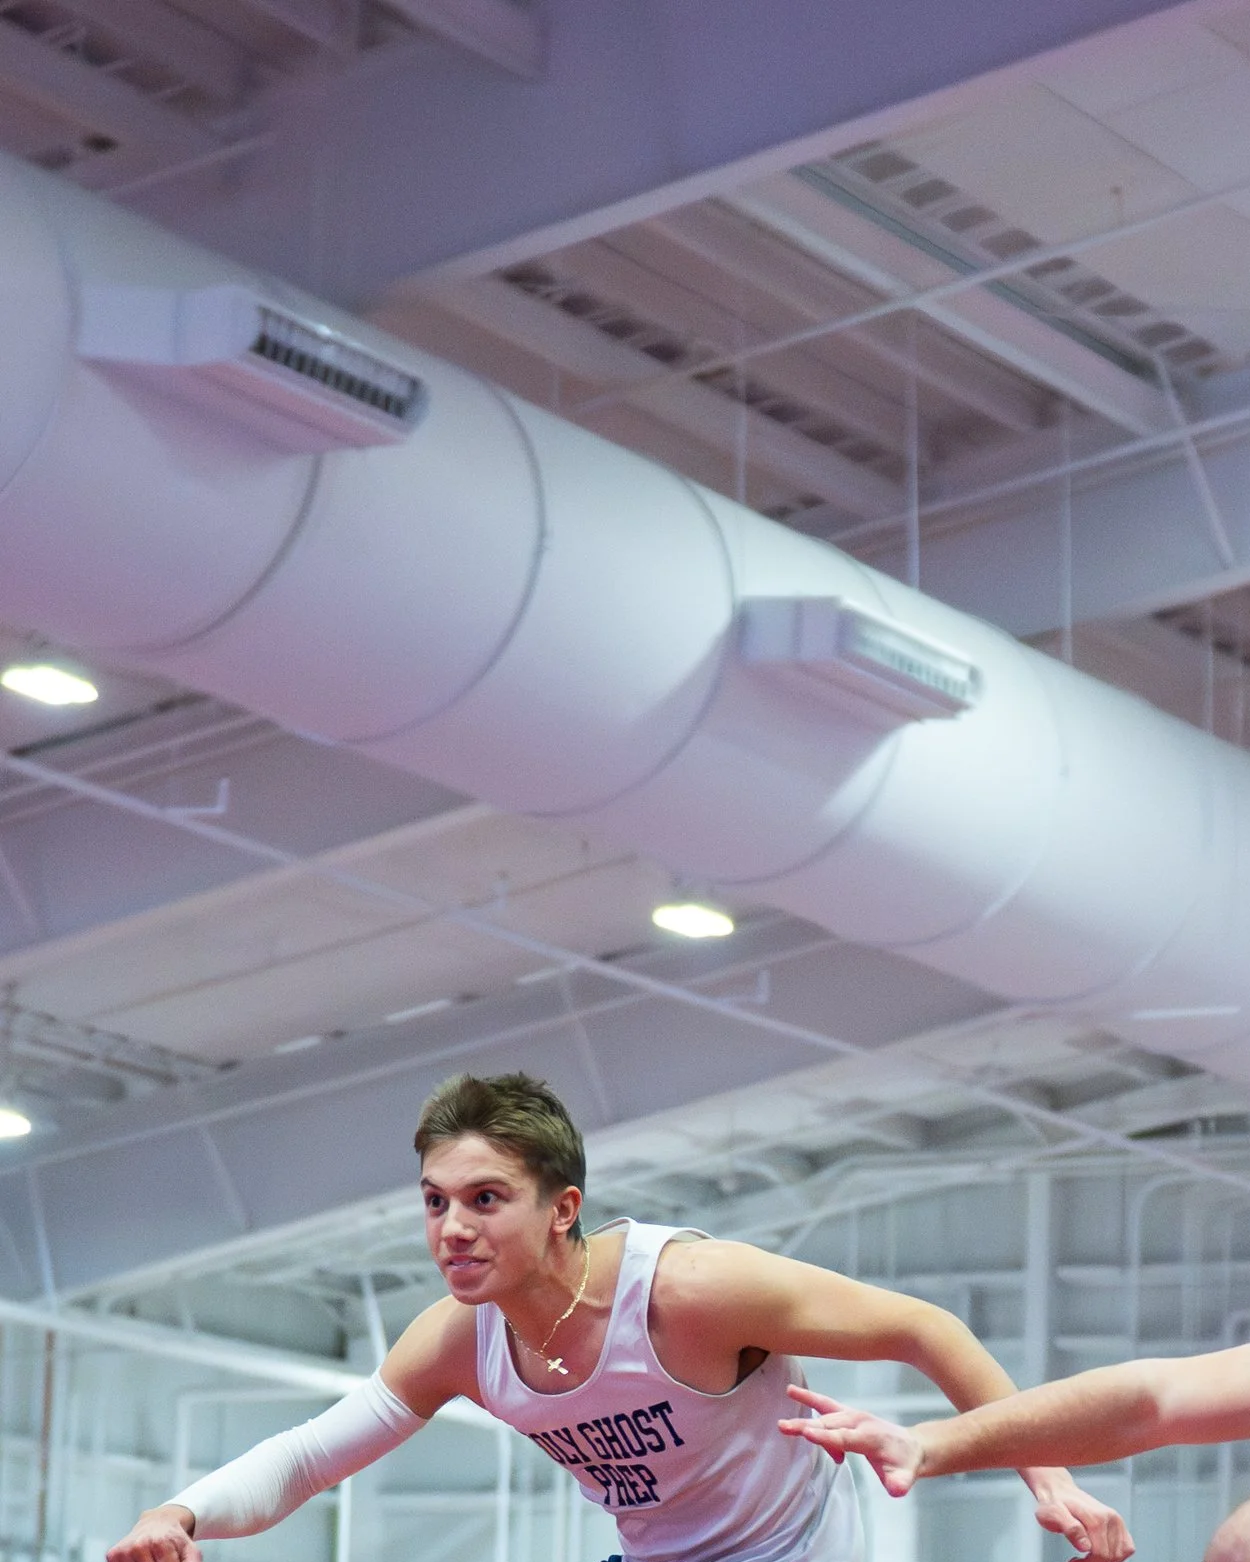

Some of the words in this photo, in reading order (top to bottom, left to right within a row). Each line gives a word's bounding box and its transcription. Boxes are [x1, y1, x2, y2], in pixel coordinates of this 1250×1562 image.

[525, 1427, 591, 1464] OLY
[577, 1401, 685, 1460] GHOST
[584, 1463, 661, 1506] PREP
